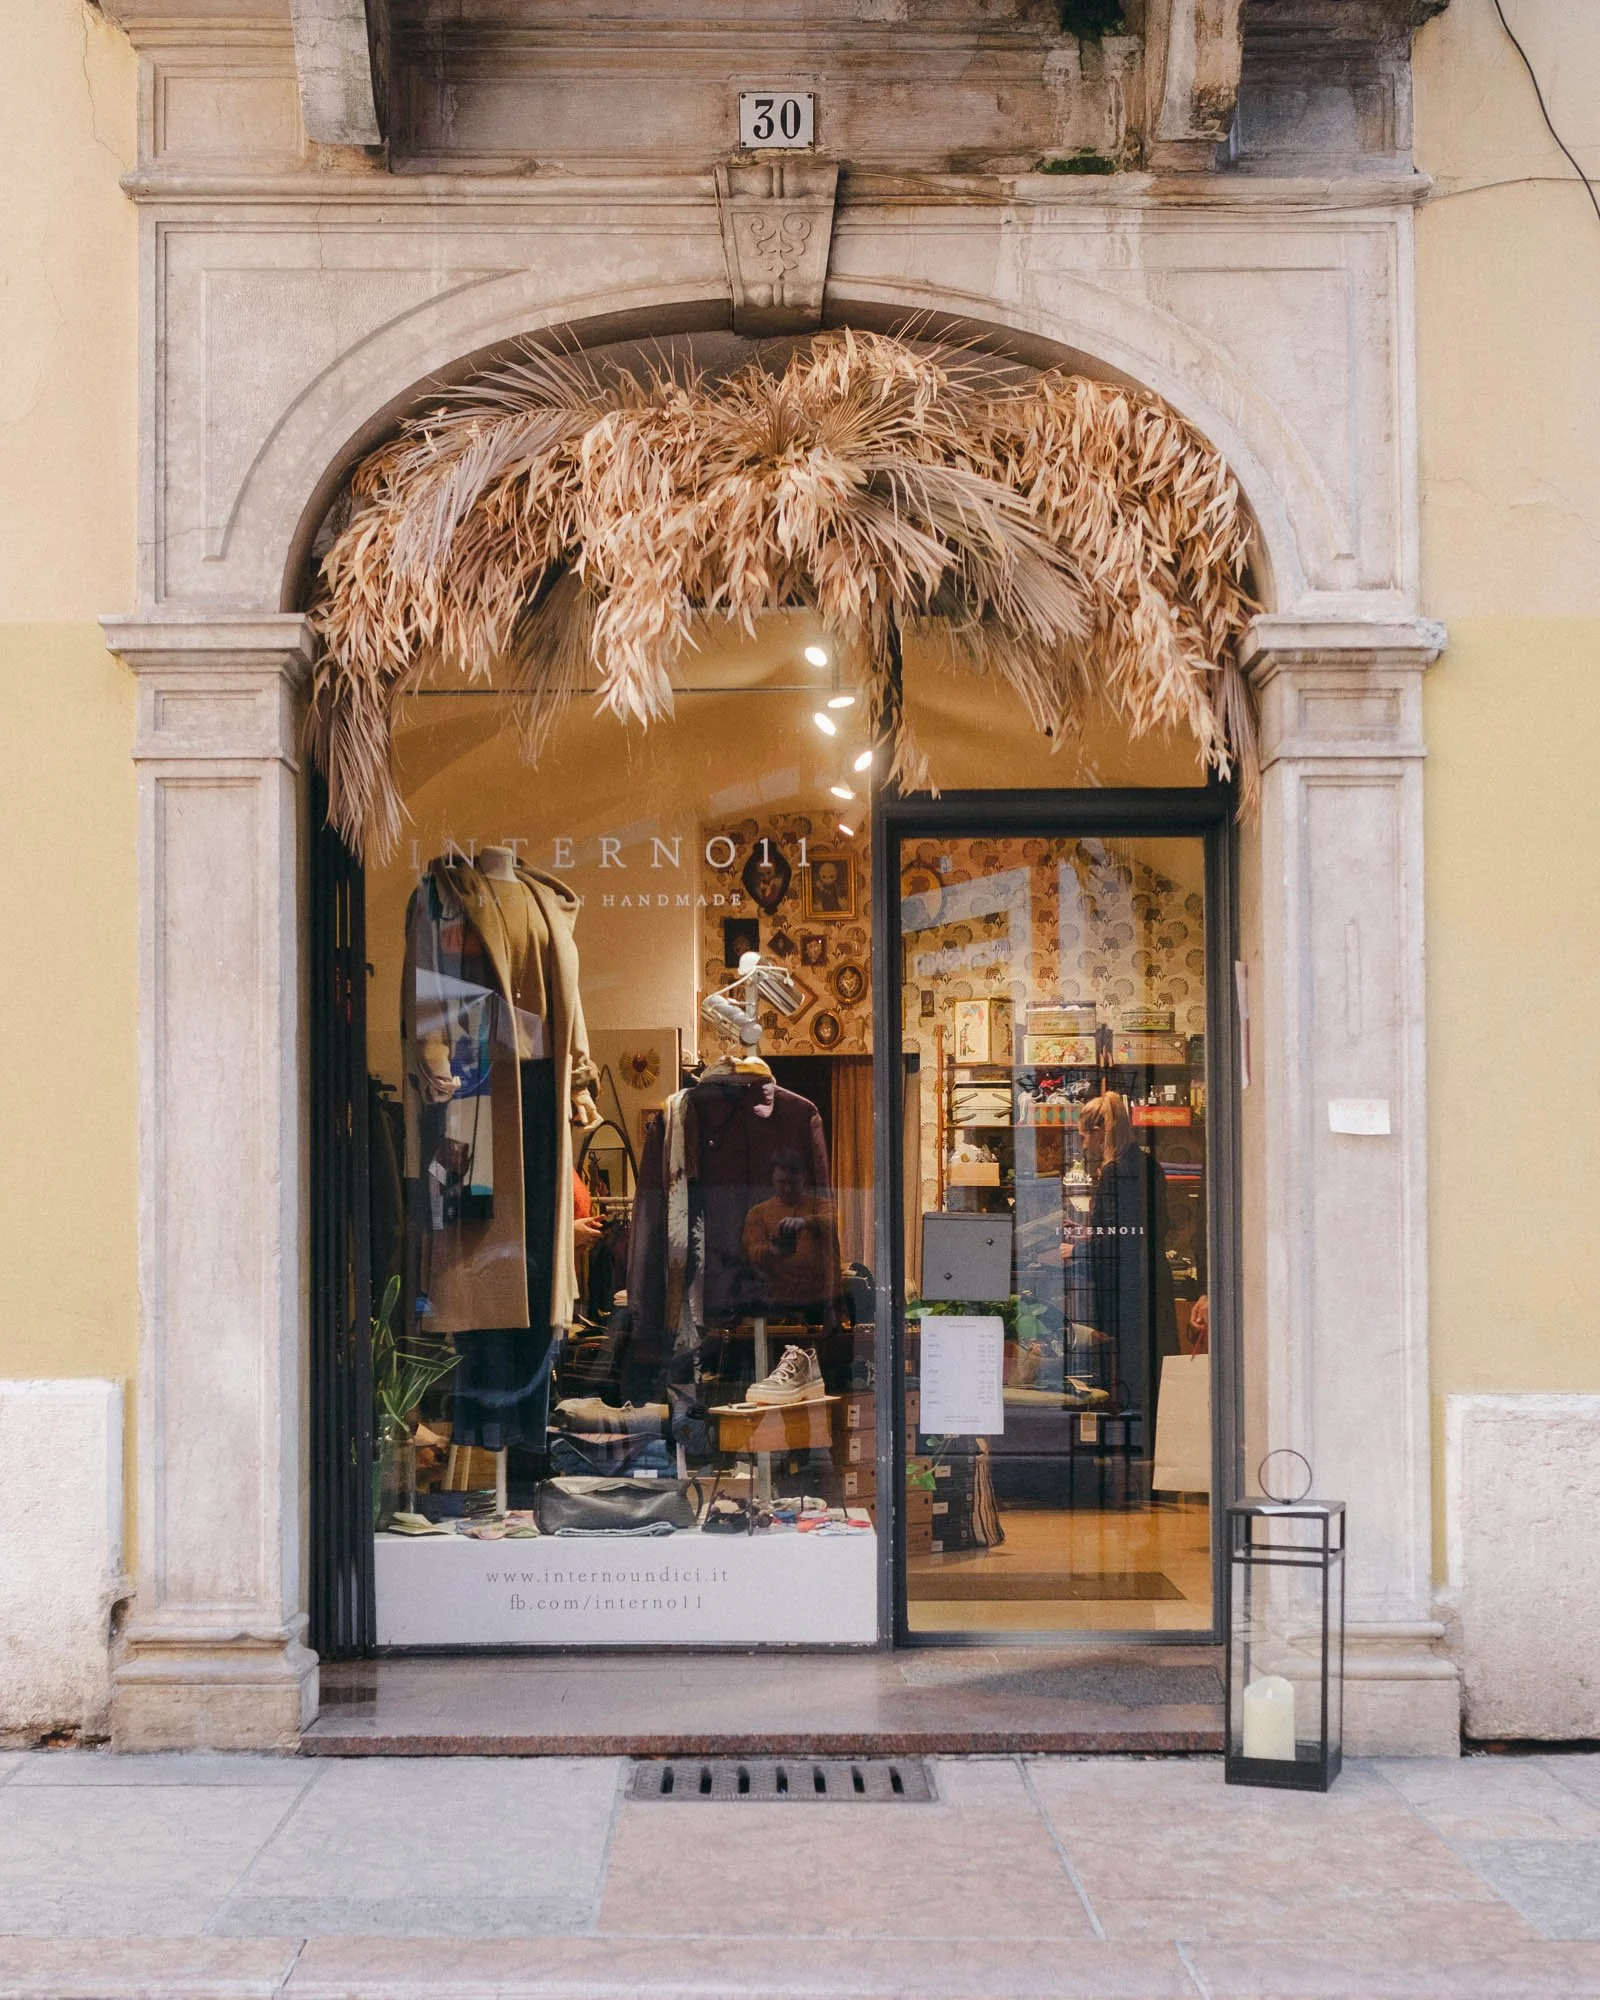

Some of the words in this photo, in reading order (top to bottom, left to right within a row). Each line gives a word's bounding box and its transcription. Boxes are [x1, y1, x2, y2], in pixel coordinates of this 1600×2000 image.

[753, 99, 801, 139] 30
[408, 835, 811, 870] INTERNO11
[602, 893, 743, 908] HANDMADE
[485, 1566, 729, 1583] www.internoundici.it
[508, 1593, 703, 1611] fb.com/interno11
